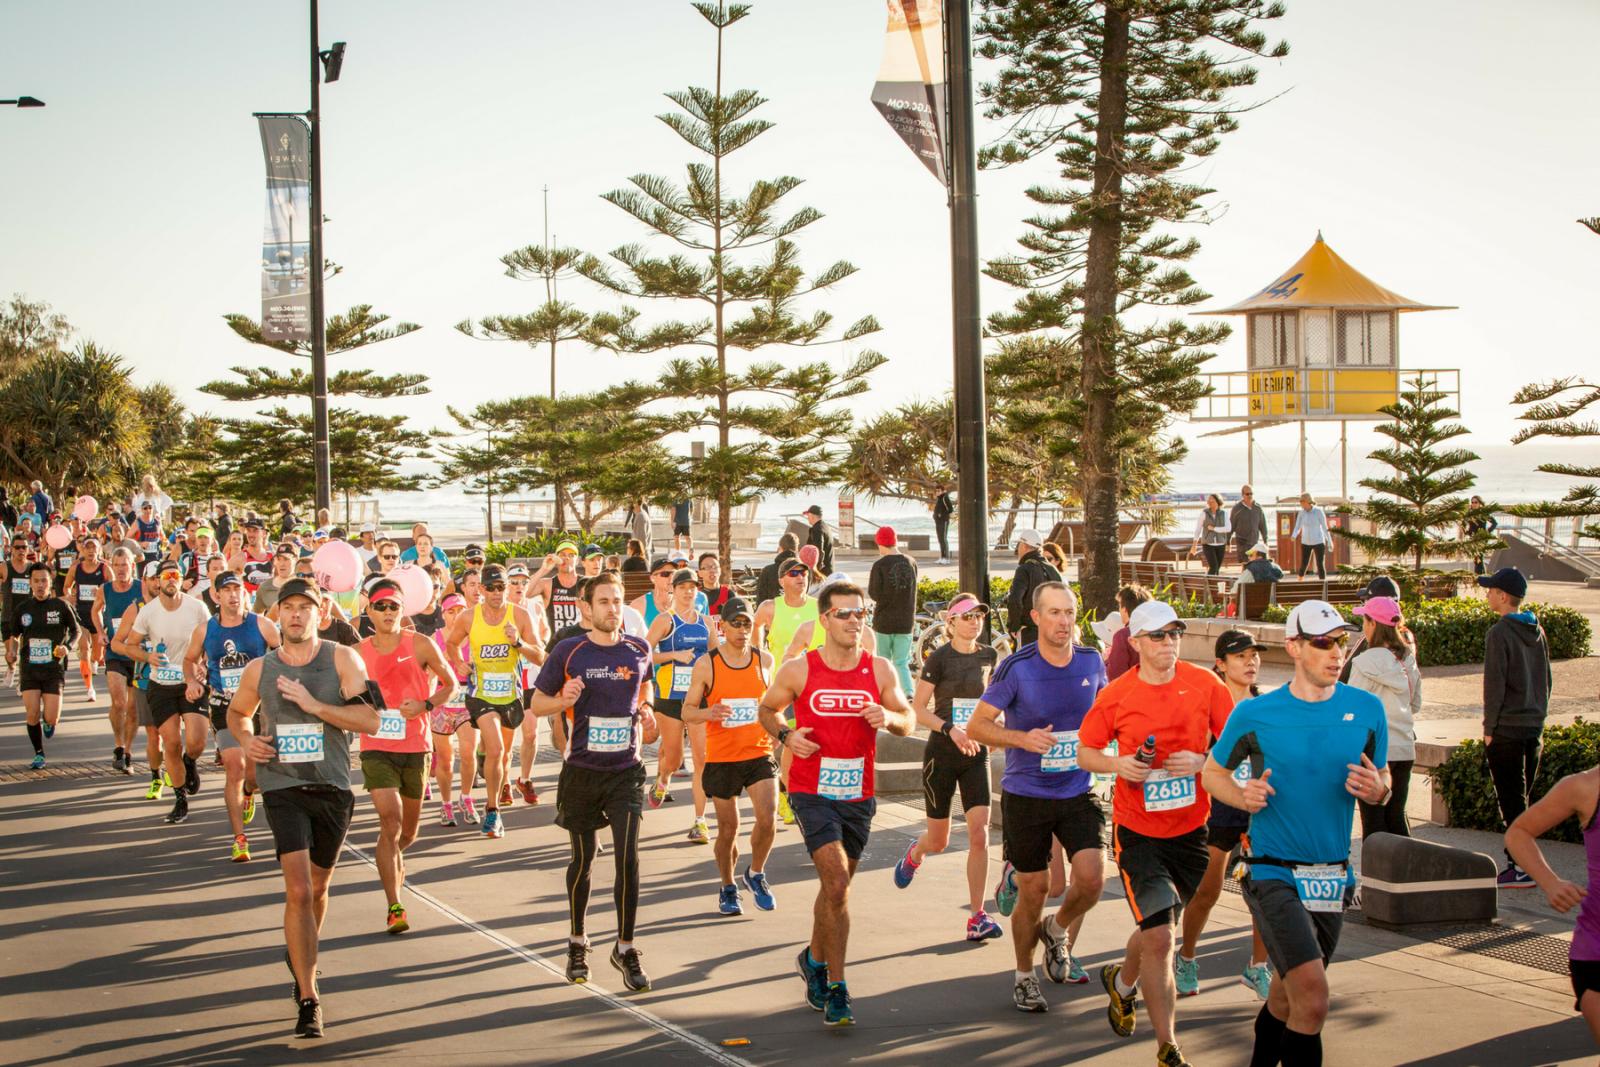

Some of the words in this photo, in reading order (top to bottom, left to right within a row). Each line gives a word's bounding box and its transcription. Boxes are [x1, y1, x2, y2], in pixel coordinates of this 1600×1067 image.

[30, 649, 48, 657] 5163
[481, 644, 510, 659] RCR
[157, 670, 181, 681] 6254
[225, 676, 241, 687] 82
[586, 671, 625, 679] triathlon
[483, 680, 510, 691] 6395
[819, 695, 864, 708] STG
[380, 719, 400, 731] 60
[588, 728, 627, 743] 3842
[278, 736, 318, 753] 2300
[820, 769, 859, 786] 2283
[1238, 764, 1252, 779] 3
[1147, 778, 1189, 801] 2681
